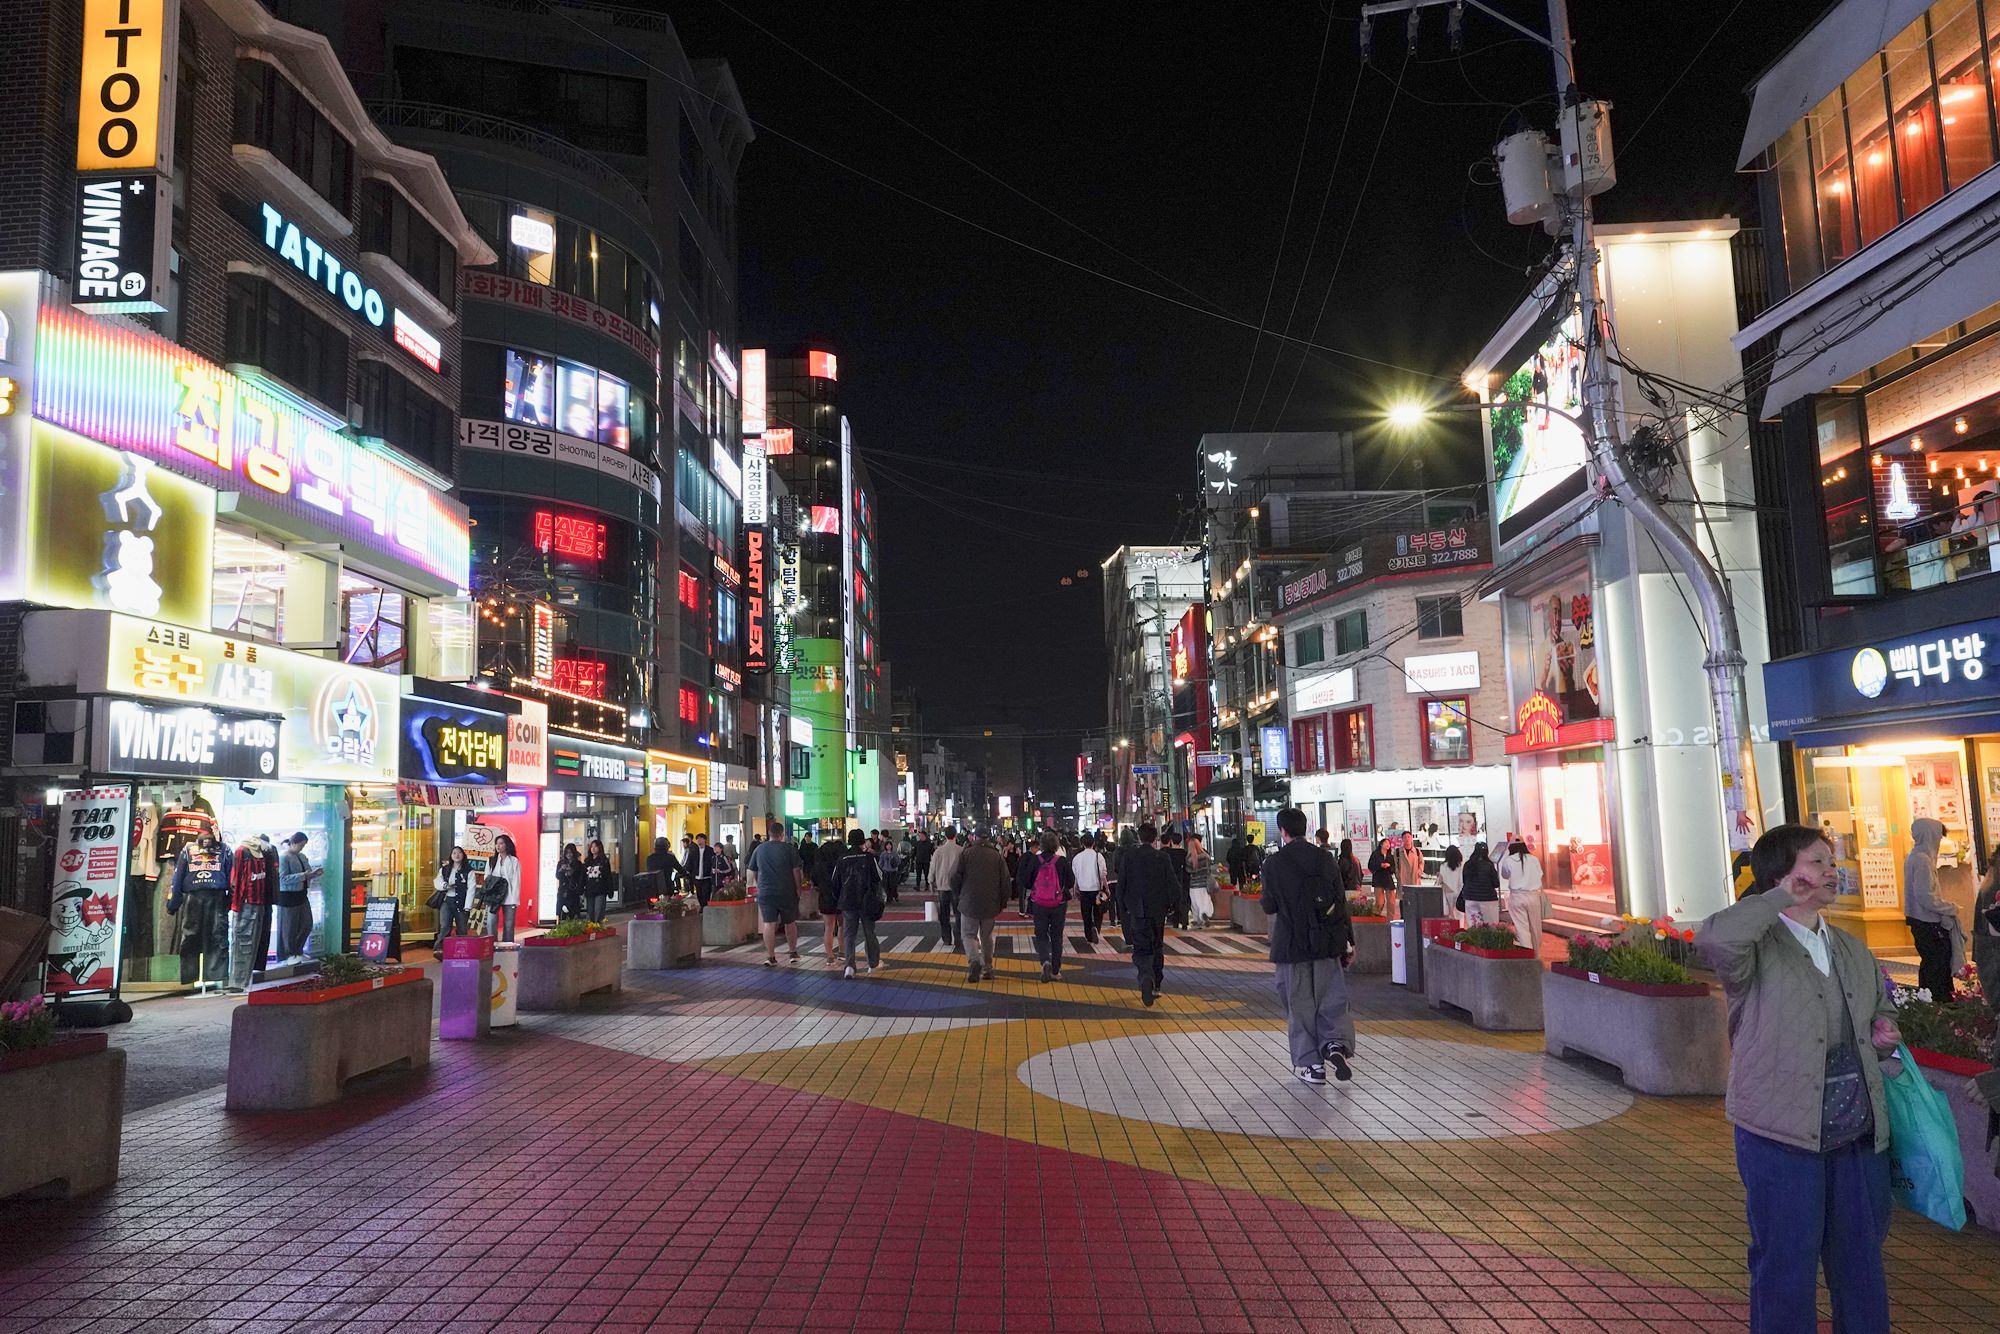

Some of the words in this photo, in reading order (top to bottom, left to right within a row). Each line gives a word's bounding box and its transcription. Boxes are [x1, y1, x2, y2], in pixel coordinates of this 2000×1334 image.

[79, 180, 122, 298] VINTAGE
[262, 201, 384, 327] TATTOO
[124, 279, 142, 290] B1
[507, 427, 553, 455] 양궁
[558, 443, 596, 460] SHOOTING
[601, 454, 628, 471] ARCHERY
[1410, 527, 1467, 551] 부동산
[748, 531, 763, 594] DART
[1387, 554, 1427, 571] 상가전문
[1431, 548, 1479, 565] 322.7888
[147, 626, 190, 650] 스크린
[748, 597, 764, 658] FLEX
[134, 647, 204, 694] 농구
[1889, 633, 1986, 687] 빽다방
[117, 707, 216, 764] VINTAGE
[233, 718, 276, 749] PLUS
[515, 722, 542, 745] COIN
[440, 727, 502, 770] 전자담배
[508, 749, 541, 768] ARAOKE
[71, 807, 119, 825] TAT
[69, 824, 116, 843] TOO
[61, 852, 87, 868] 3F
[91, 859, 115, 867] Tattoo
[89, 871, 114, 879] Design
[365, 940, 383, 951] 1+1
